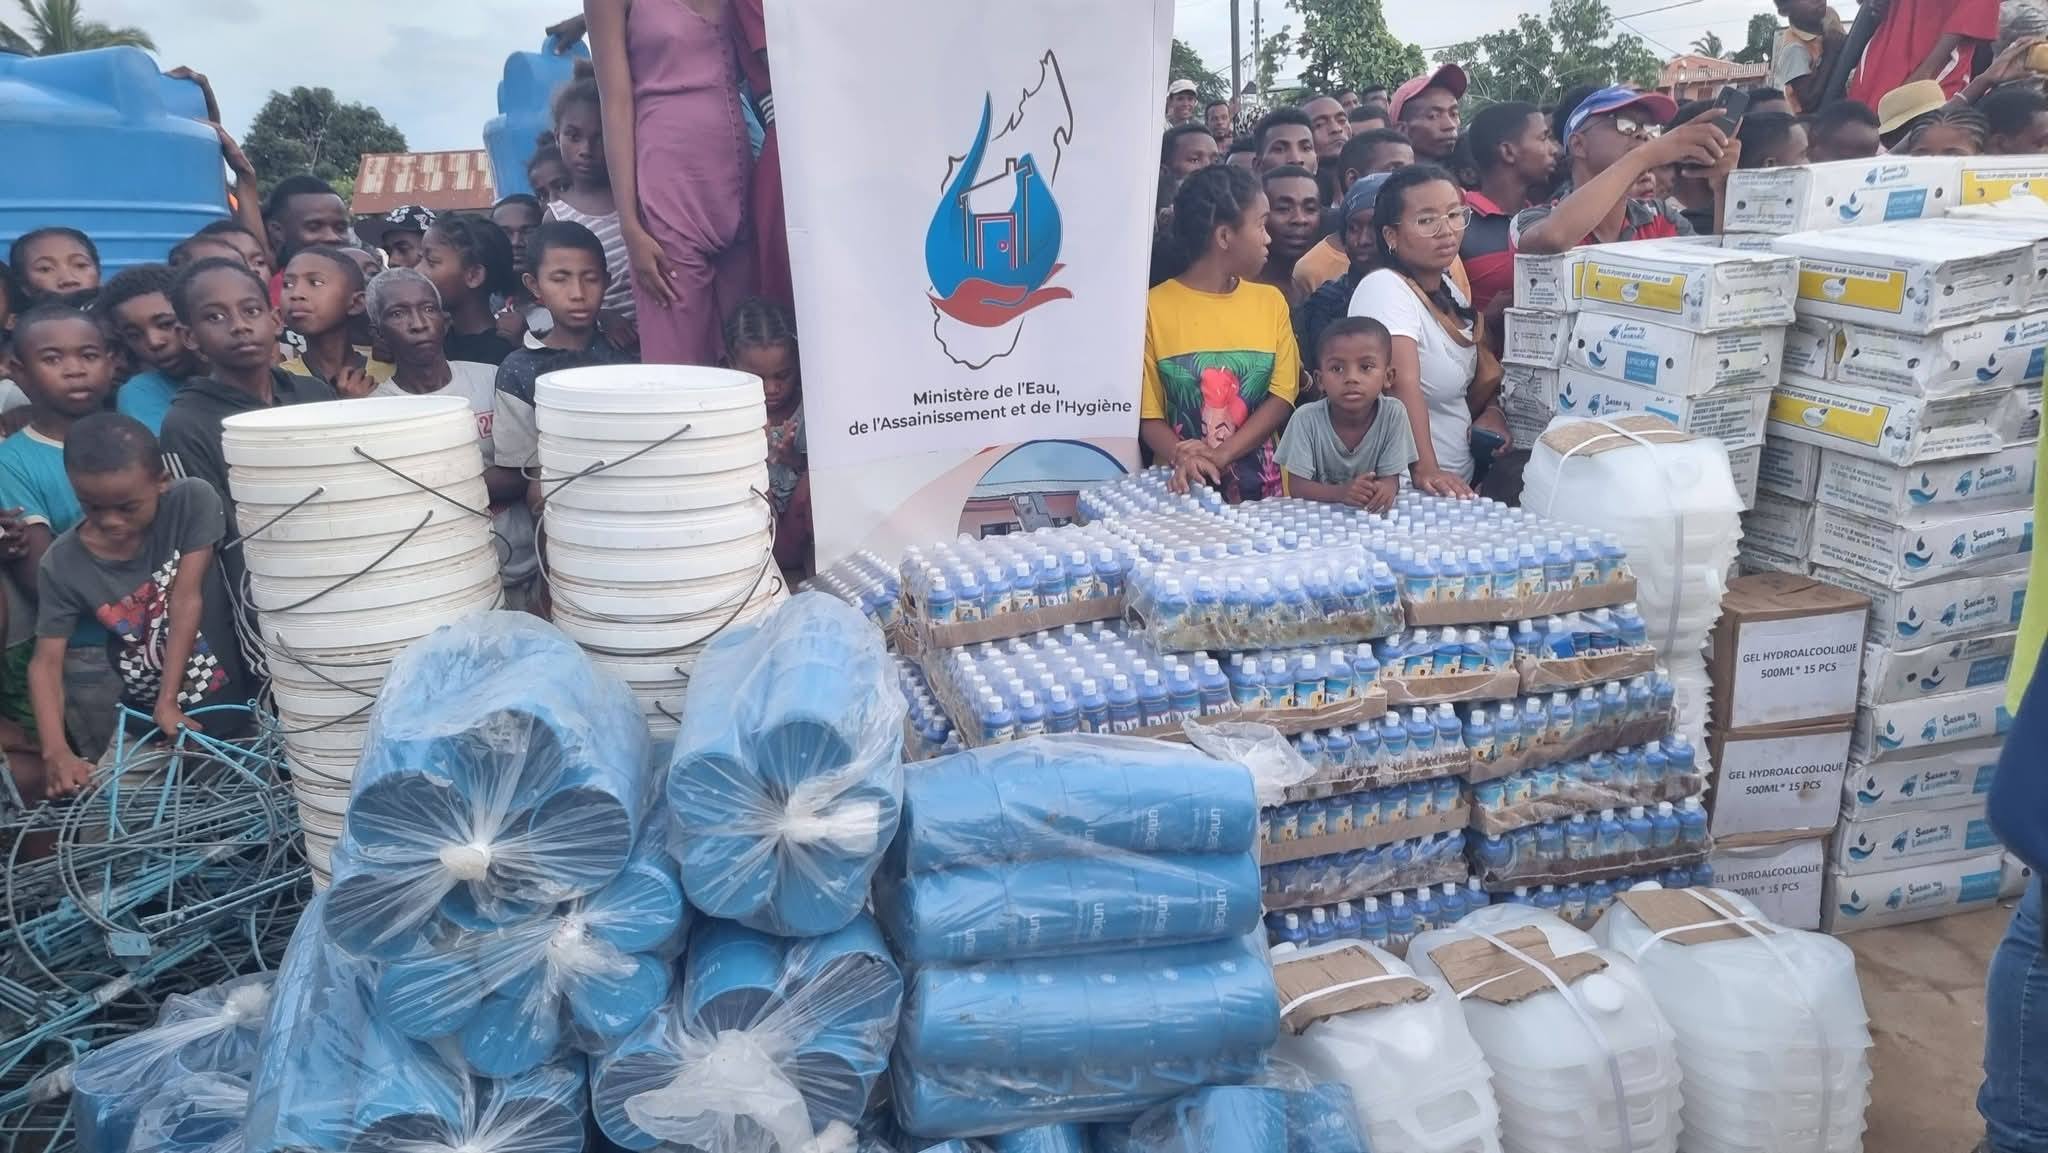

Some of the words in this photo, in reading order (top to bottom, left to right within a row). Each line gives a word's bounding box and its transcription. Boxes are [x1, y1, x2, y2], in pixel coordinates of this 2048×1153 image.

[913, 387, 989, 406] Ministère
[993, 383, 1013, 398] de
[1017, 380, 1060, 398] l'Eau,
[1818, 397, 1830, 405] BAR
[1831, 400, 1848, 408] SOAP
[848, 419, 869, 436] de
[873, 405, 1007, 431] l'Assainissement
[1010, 402, 1027, 416] et
[1030, 400, 1051, 415] de
[1055, 398, 1132, 418] l'Hygiène
[1743, 653, 1760, 663] GEL
[1763, 642, 1857, 661] HYDROALCOOLIQUE
[1803, 664, 1816, 674] 15
[1818, 662, 1837, 673] PCS
[1728, 771, 1746, 780] GEL
[1748, 762, 1844, 778] HYDROALCOOLIQUE
[1788, 782, 1800, 792] 15
[1803, 780, 1822, 790] PCS
[1728, 864, 1820, 882] HYDROALCOOLIQUE
[1768, 885, 1779, 894] 15
[1782, 882, 1800, 892] PCS
